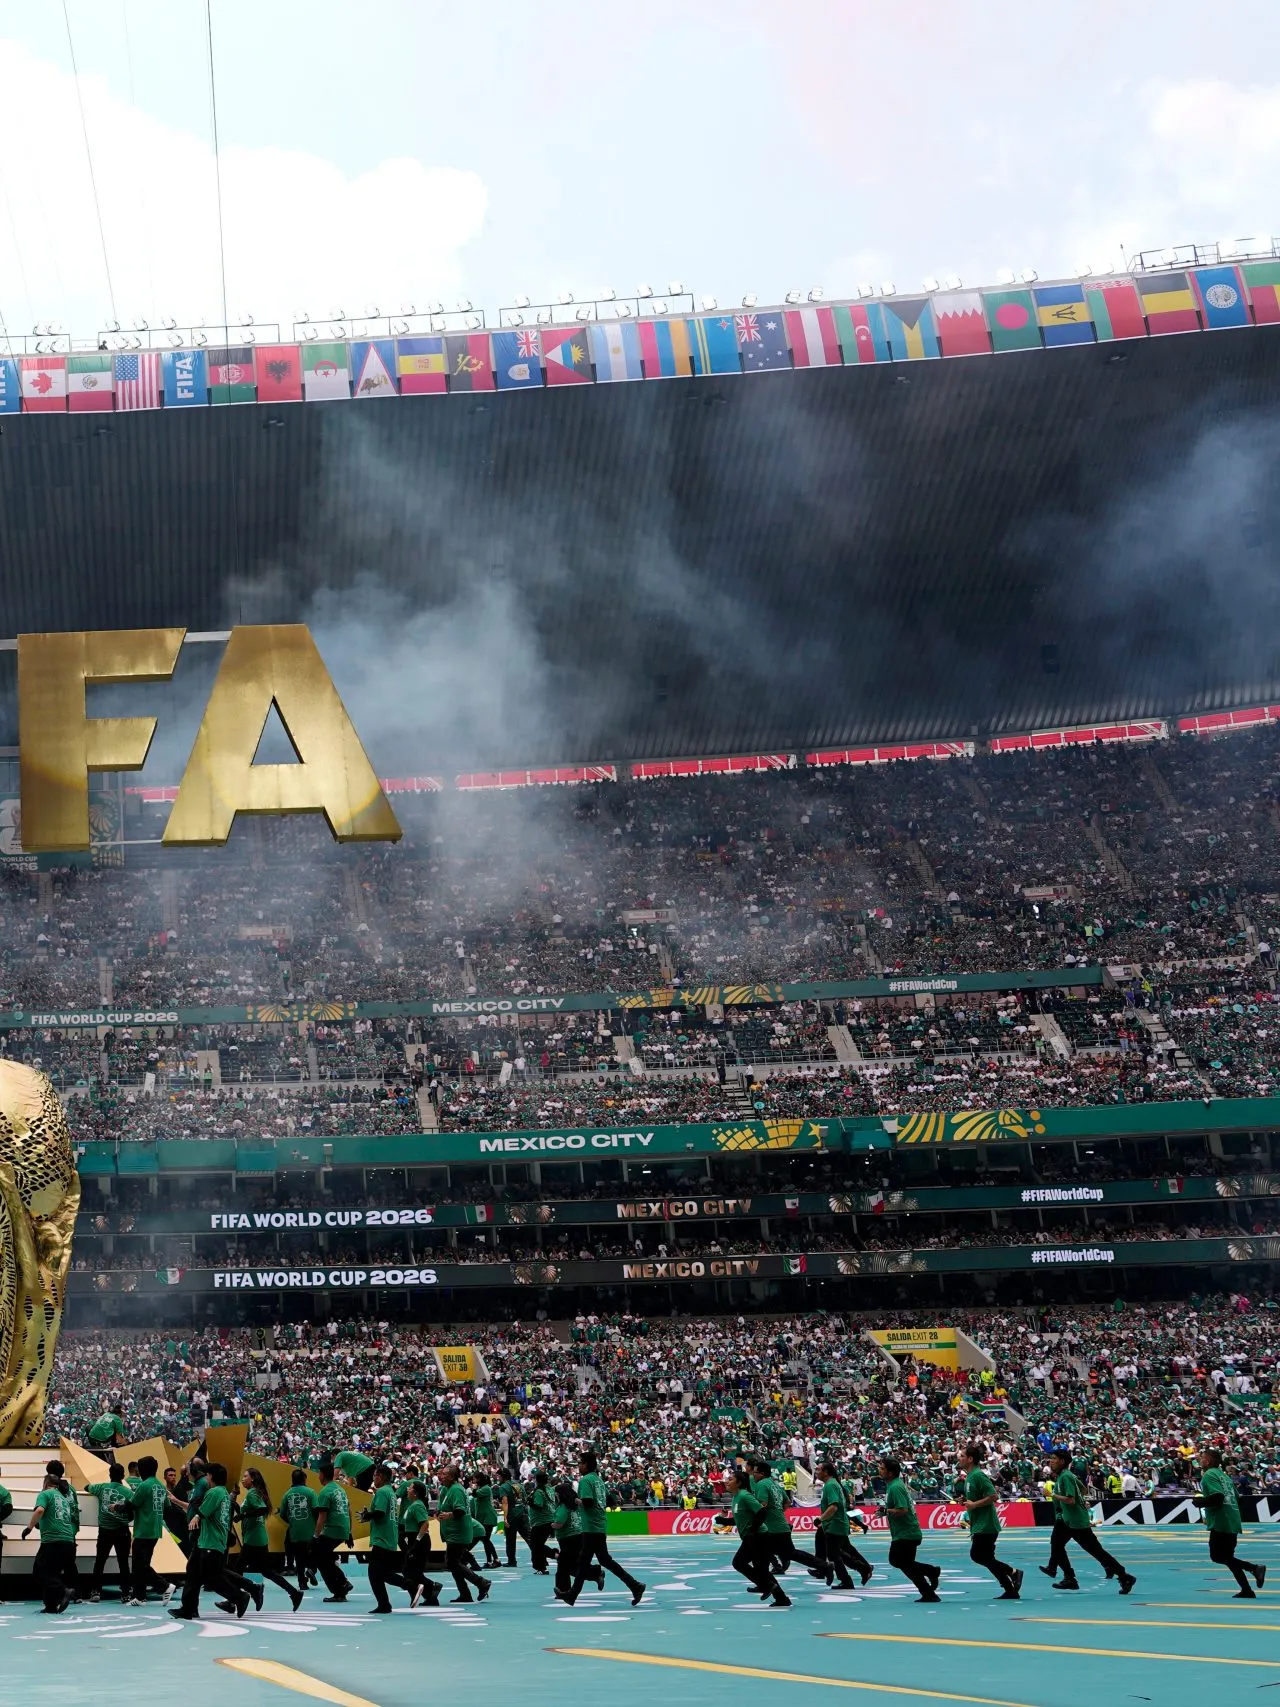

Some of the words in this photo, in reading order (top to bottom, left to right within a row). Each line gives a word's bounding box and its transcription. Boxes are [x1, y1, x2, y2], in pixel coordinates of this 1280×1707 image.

[175, 357, 195, 399] FIFA
[889, 979, 958, 992] #FIFAWorldCup
[432, 999, 513, 1012] MEXICO
[515, 997, 565, 1010] CITY
[31, 1014, 58, 1025] FIFA
[59, 1013, 105, 1025] WORLD
[106, 1012, 134, 1023] CUP
[133, 1011, 179, 1023] 2026
[479, 1134, 586, 1152] MEXICO
[591, 1132, 655, 1148] CITY
[1021, 1187, 1104, 1202] #FIFAWorldCup
[703, 1198, 752, 1215] CITY
[211, 1213, 252, 1229] FIFA
[253, 1212, 322, 1228] WORLD
[324, 1211, 363, 1226] CUP
[365, 1209, 433, 1225] 2026
[1031, 1248, 1115, 1263] #FIFAWorldCup
[622, 1261, 705, 1279] MEXICO
[710, 1259, 759, 1276] CITY
[213, 1272, 255, 1288] FIFA
[256, 1271, 326, 1287] WORLD
[329, 1270, 367, 1286] CUP
[369, 1268, 438, 1285] 2026
[886, 1332, 912, 1342] SALIDA
[912, 1331, 928, 1341] EXIT
[929, 1331, 939, 1340] 28
[442, 1354, 466, 1363] SALIDA
[443, 1363, 457, 1372] EXIT
[1091, 1498, 1202, 1525] KIA
